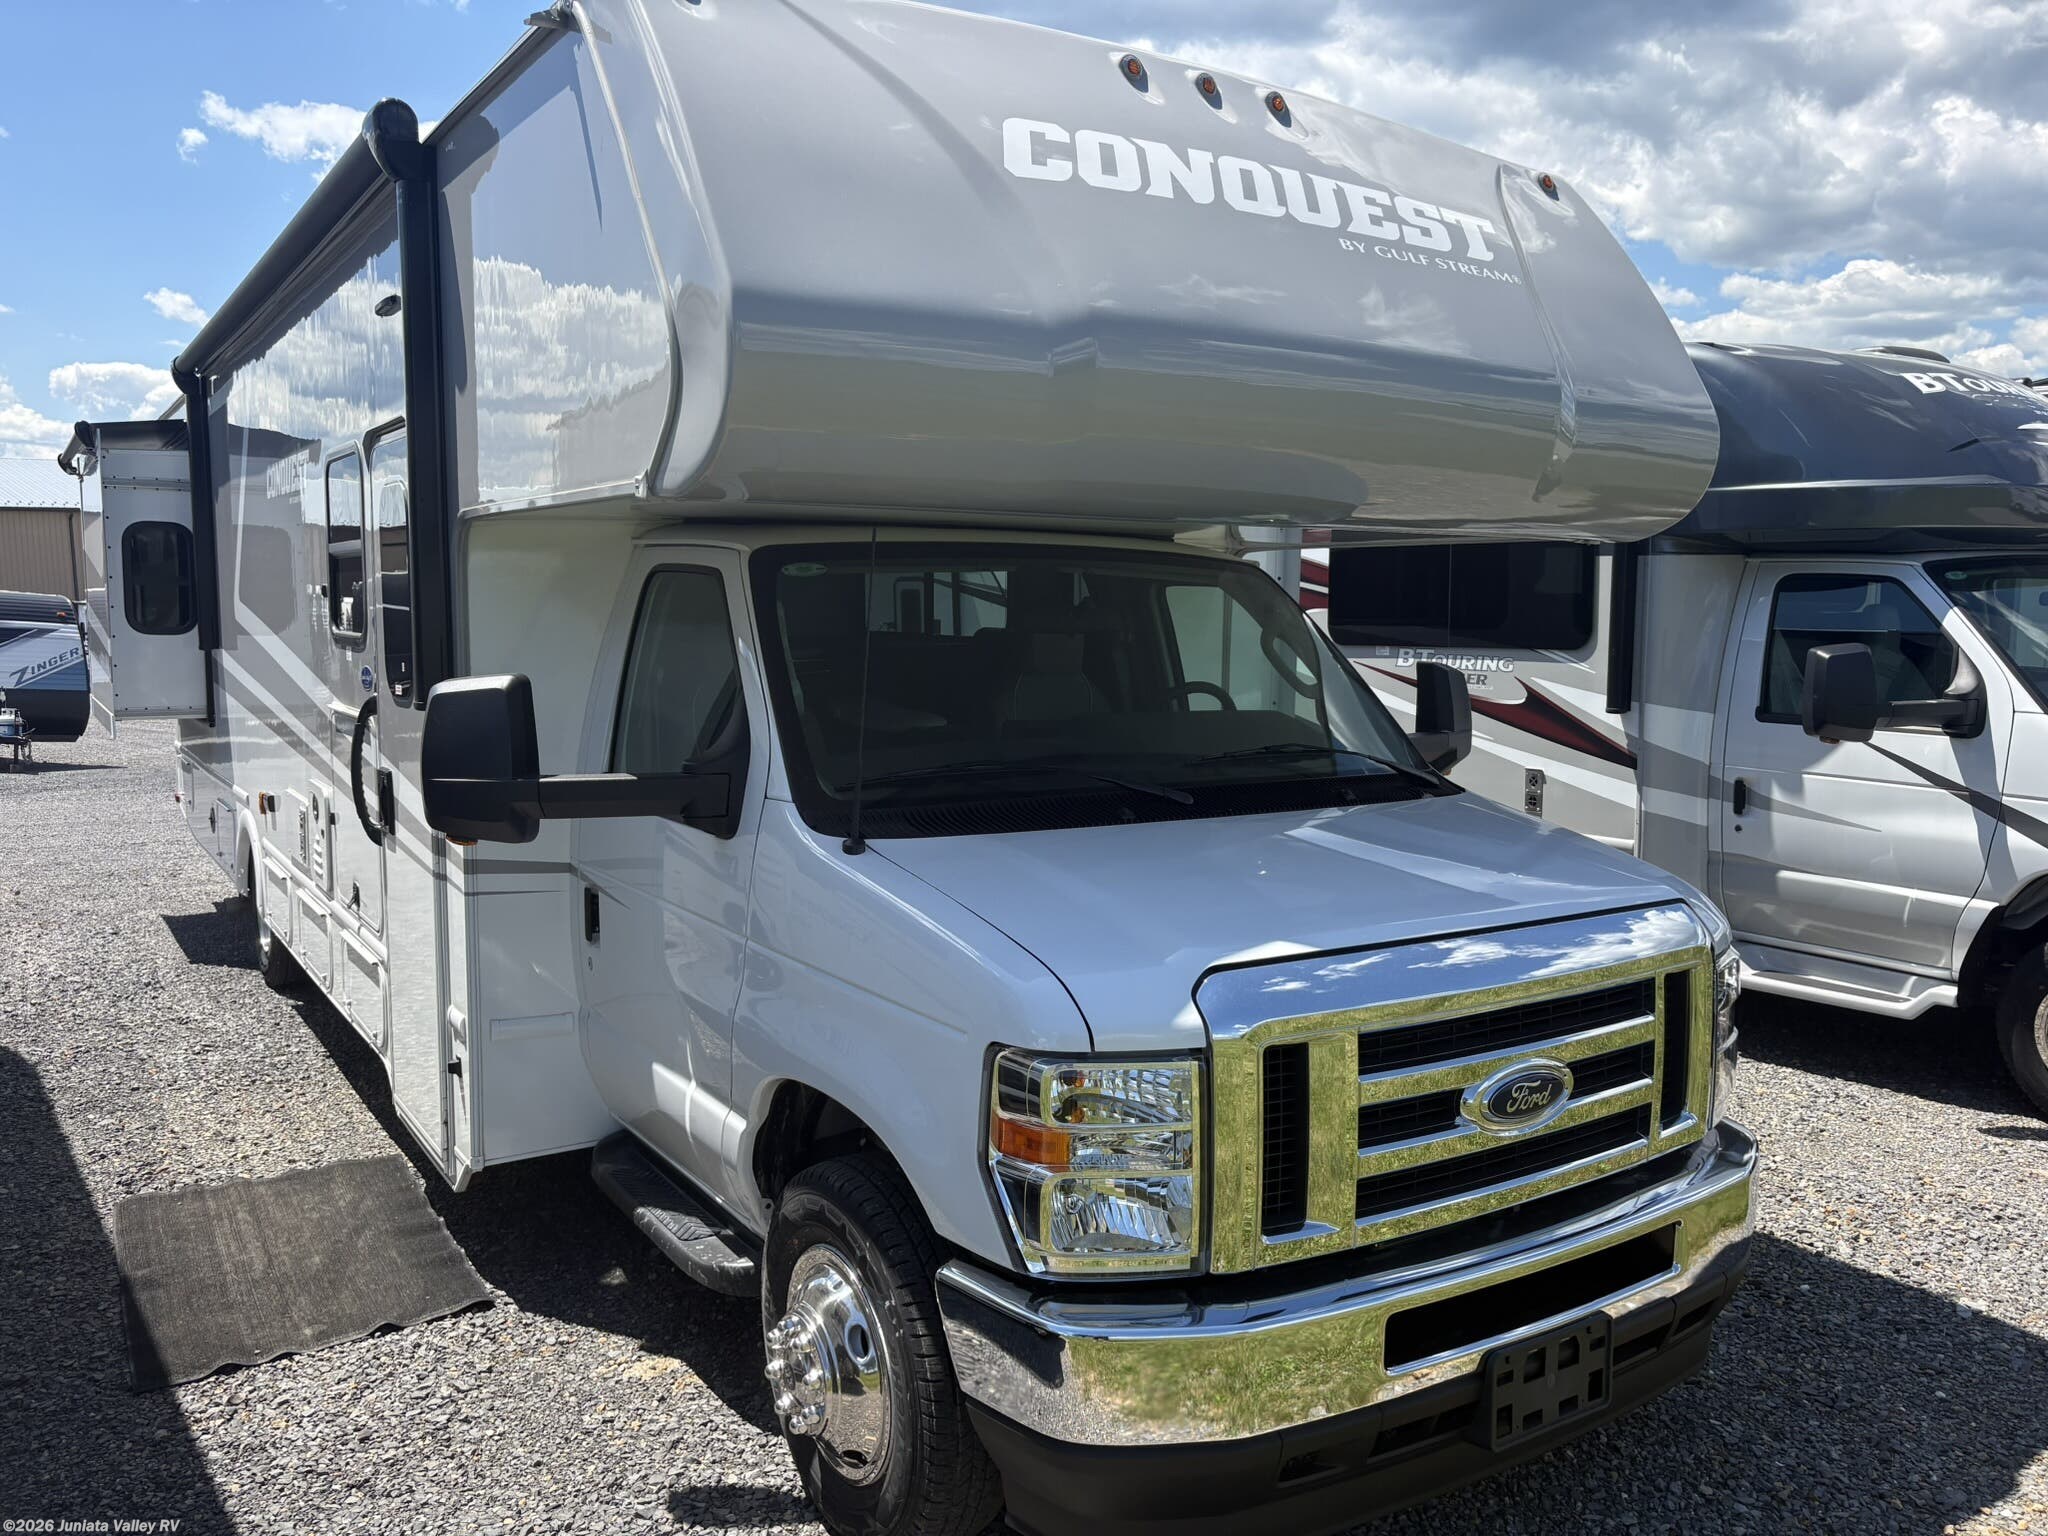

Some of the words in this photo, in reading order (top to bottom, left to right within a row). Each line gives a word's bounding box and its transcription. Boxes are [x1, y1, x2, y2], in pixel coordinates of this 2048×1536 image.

[1002, 117, 1496, 262] CONQUEST
[1338, 238, 1366, 253] BY
[1374, 246, 1430, 265] GULF
[266, 449, 310, 499] CONQUEST
[9, 647, 80, 687] ZINGER
[1506, 1079, 1552, 1113] Ford
